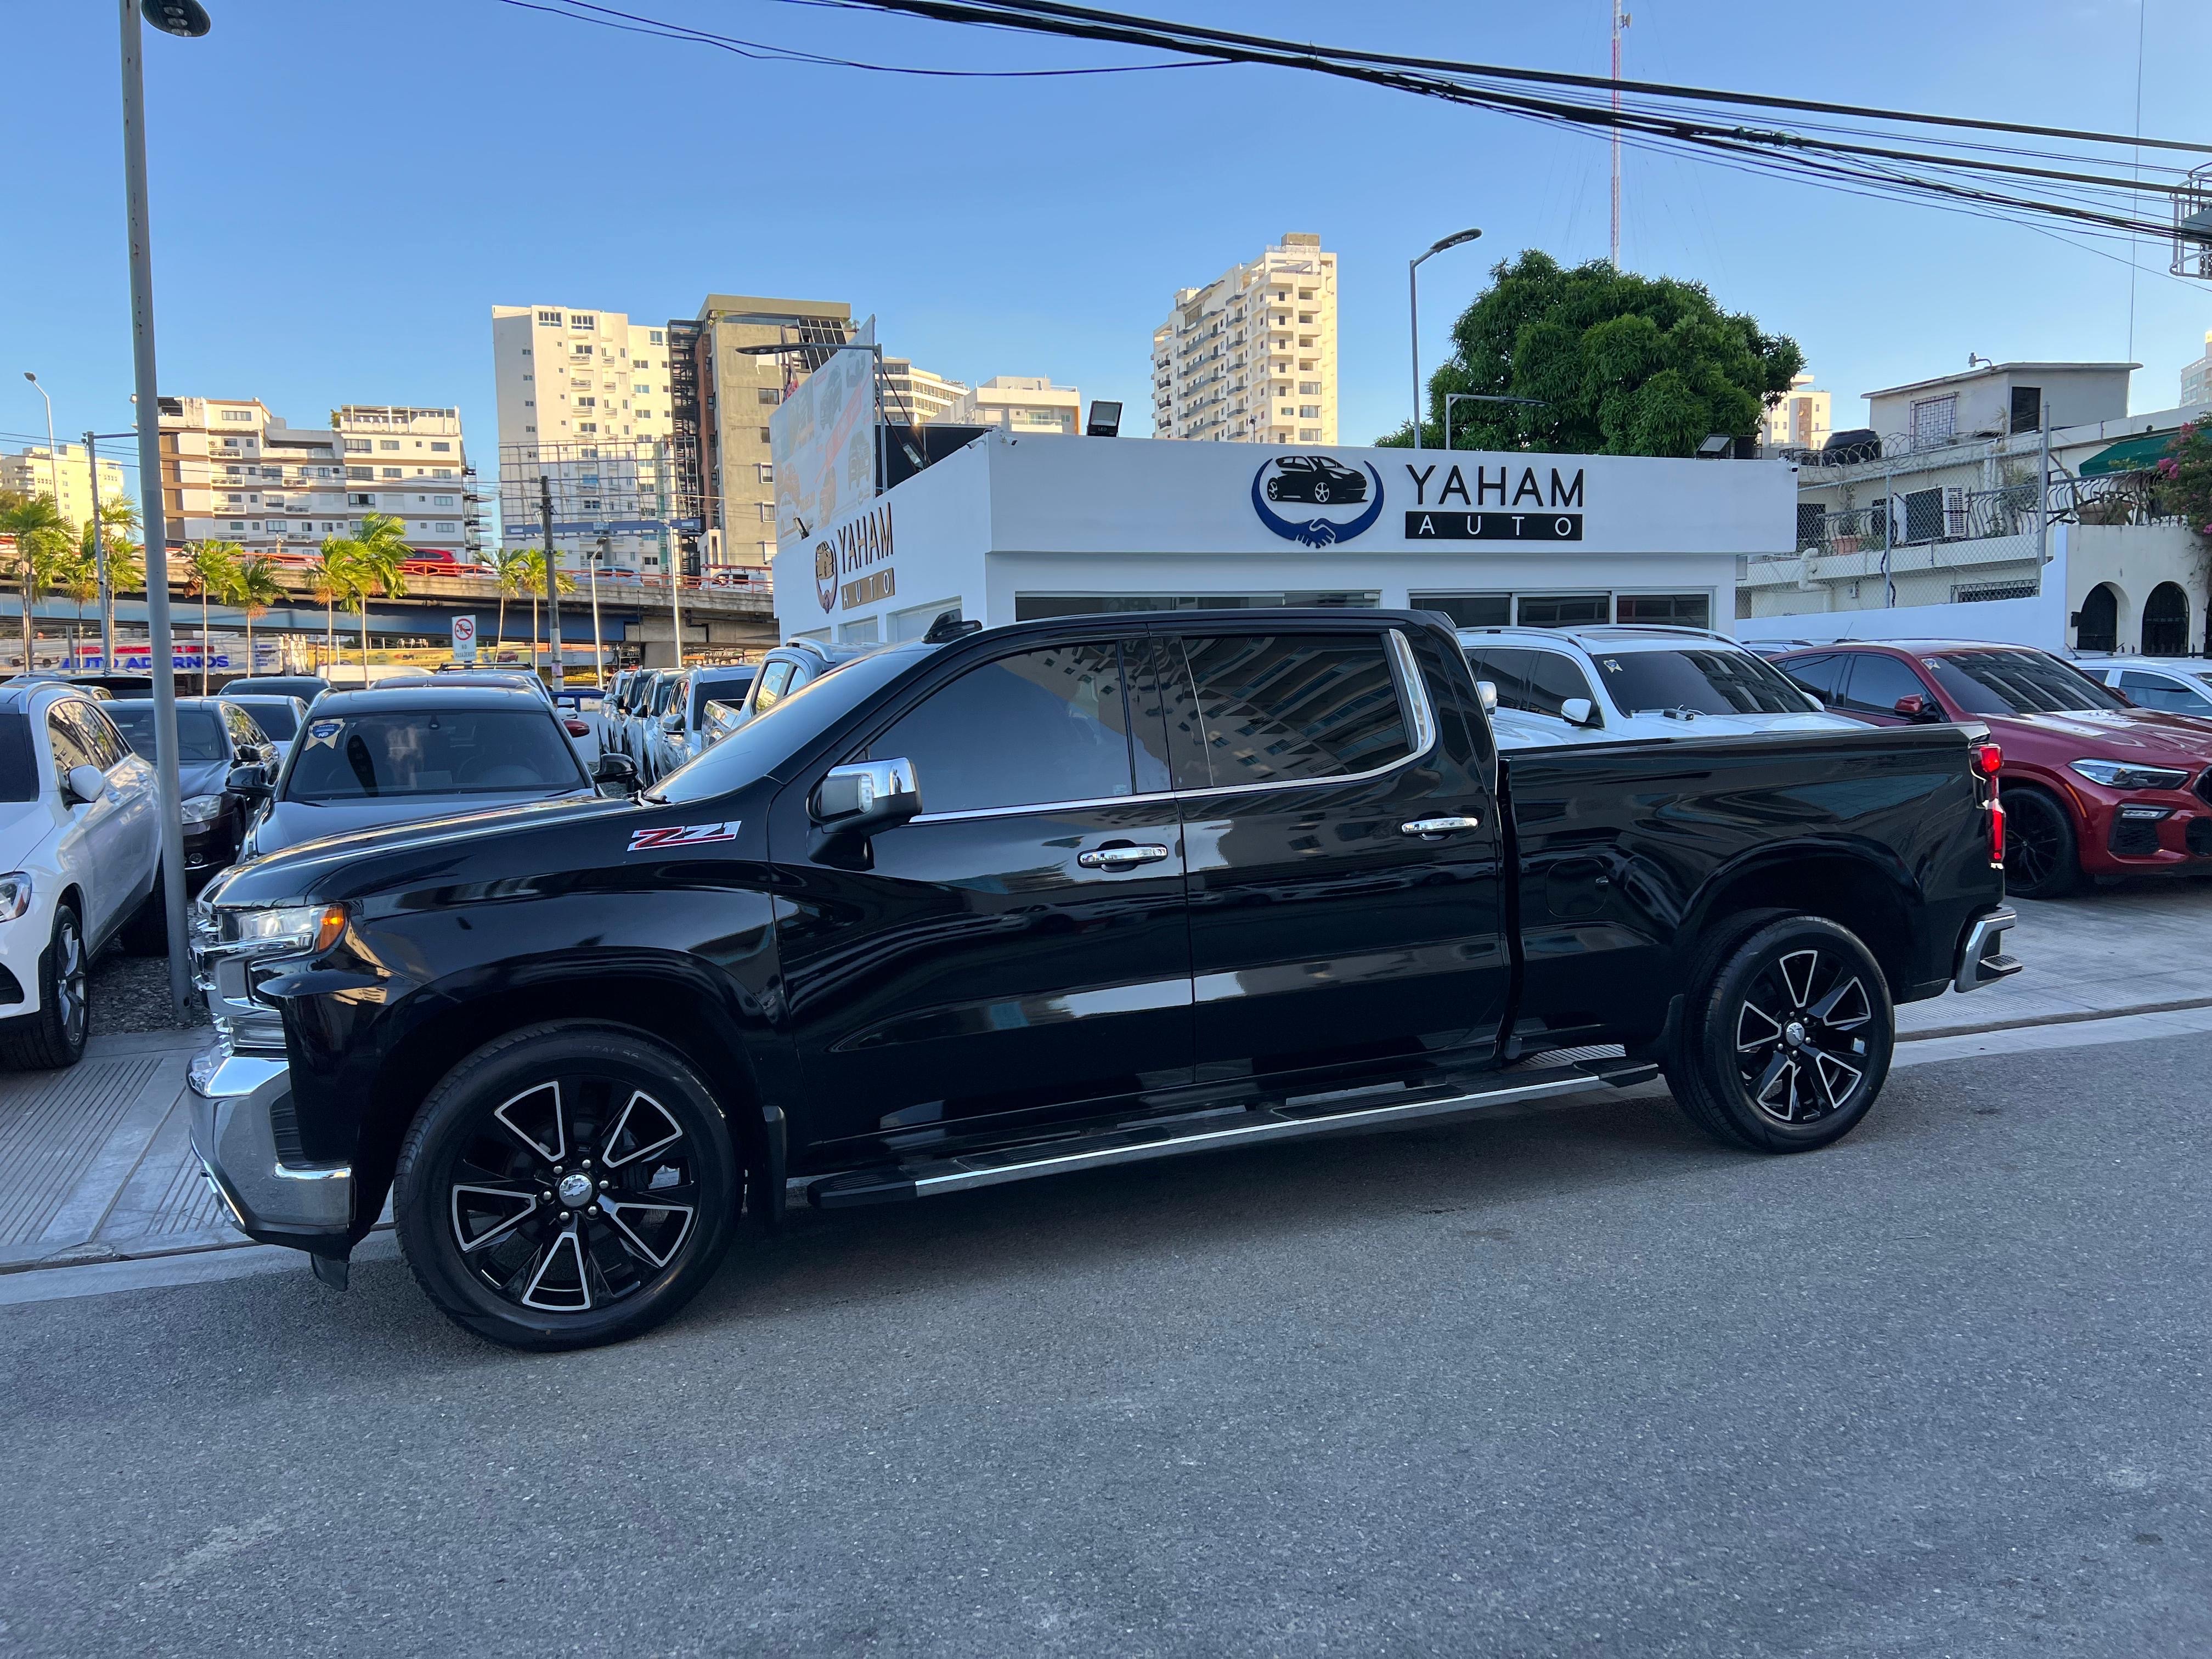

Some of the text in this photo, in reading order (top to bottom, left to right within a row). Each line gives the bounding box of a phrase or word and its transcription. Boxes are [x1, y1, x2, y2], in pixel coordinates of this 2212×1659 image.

[1406, 464, 1584, 507] YAHAM
[837, 502, 894, 574] YAHAM
[1418, 515, 1572, 537] AUTO
[843, 572, 890, 607] AUTO
[126, 656, 229, 669] ADRNOS
[627, 820, 742, 852] Z71
